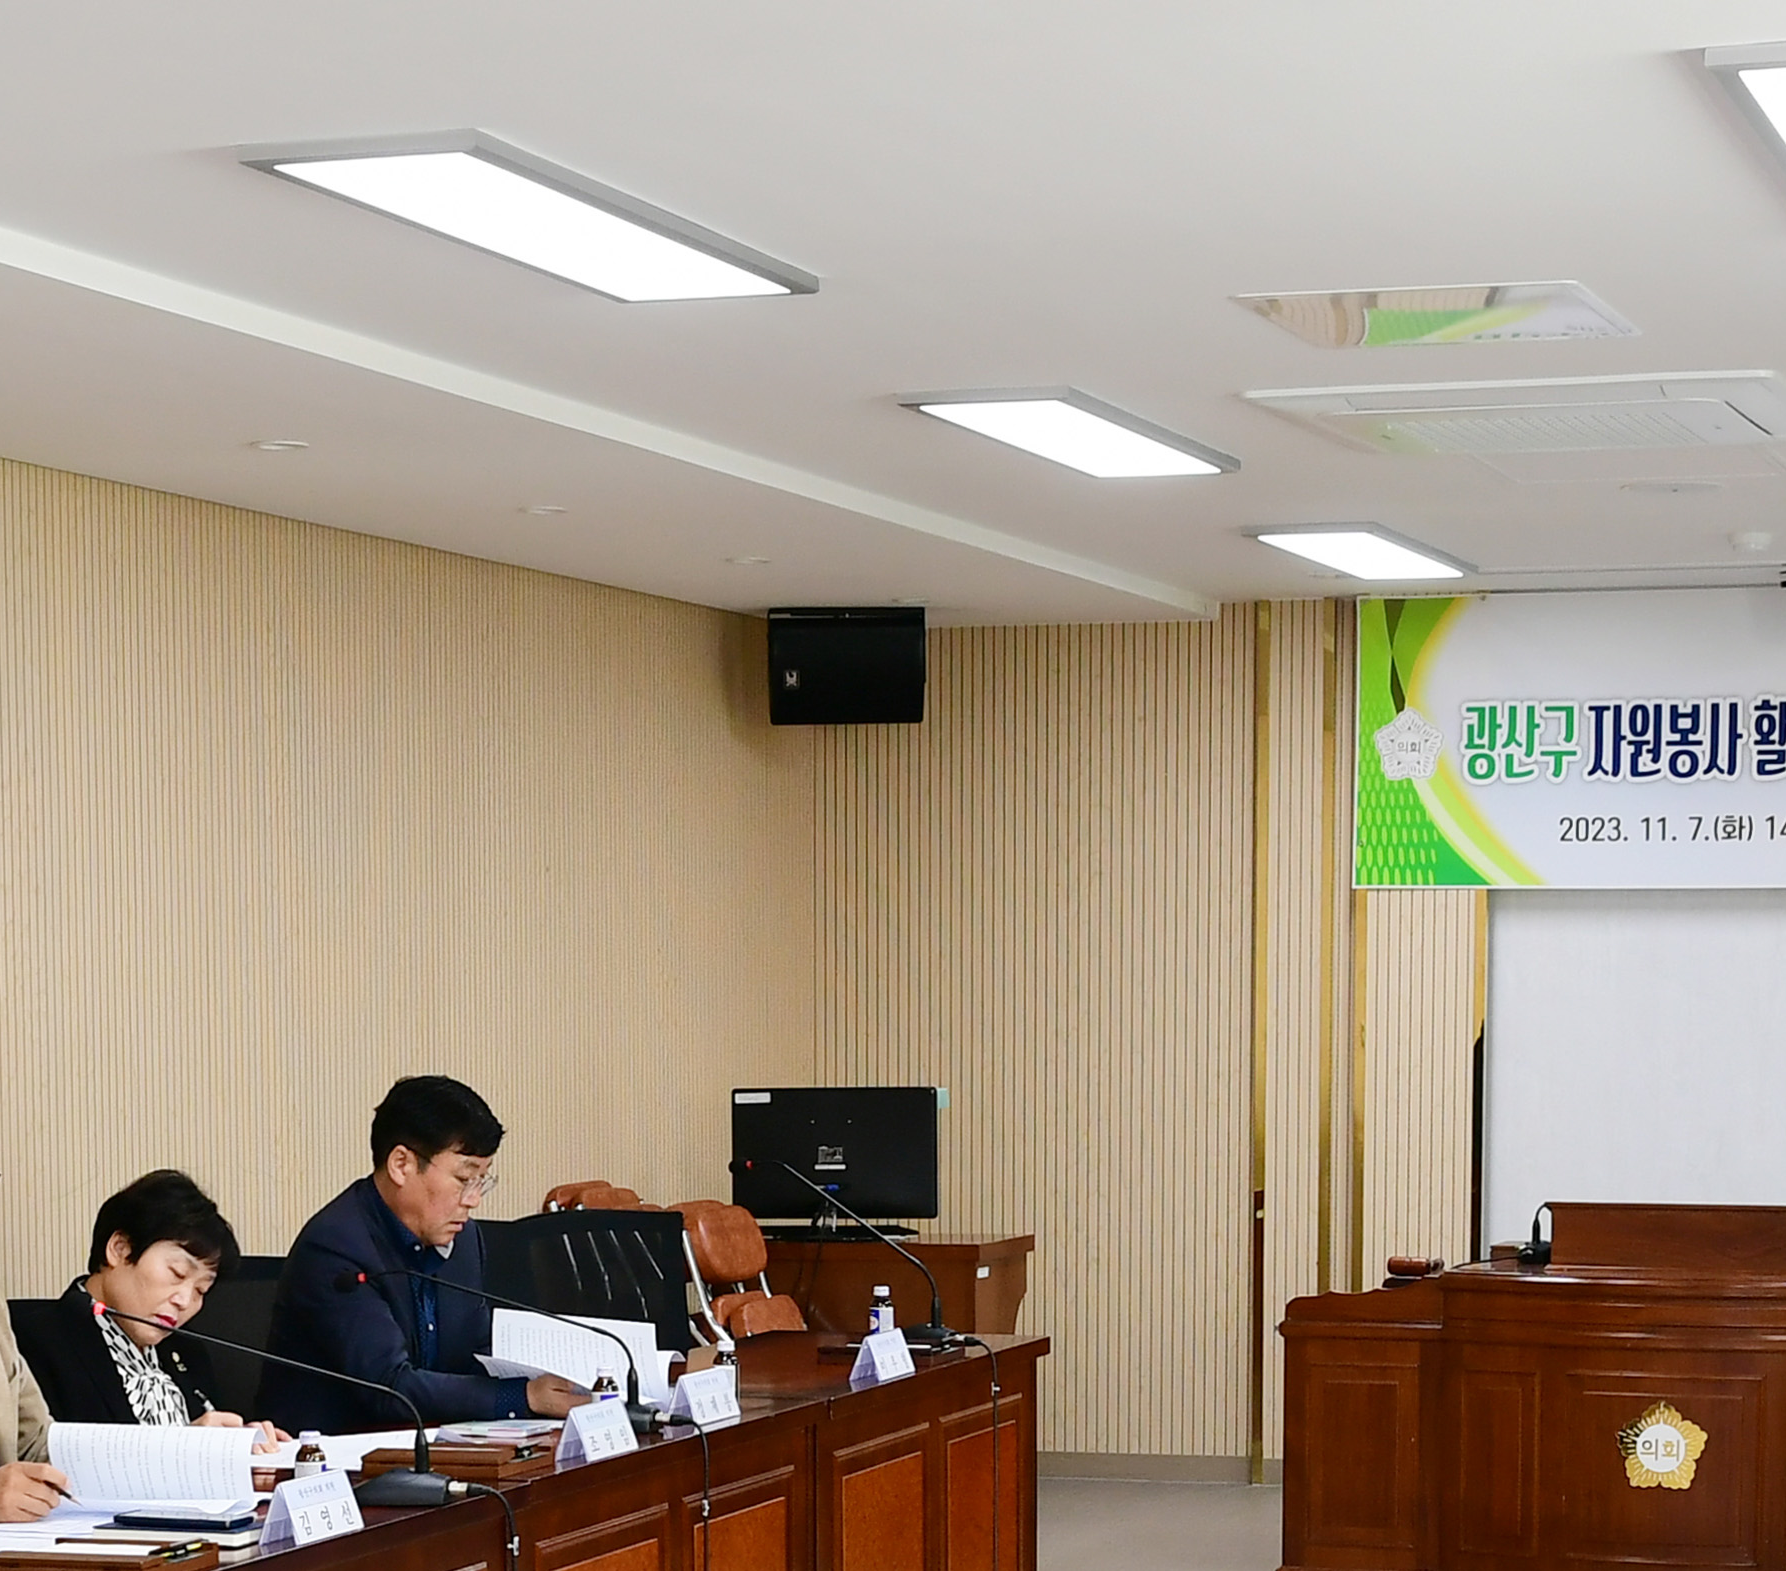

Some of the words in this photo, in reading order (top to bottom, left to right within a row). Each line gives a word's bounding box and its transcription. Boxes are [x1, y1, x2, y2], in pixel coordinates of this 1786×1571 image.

[1397, 741, 1421, 754] 의회
[1463, 704, 1579, 780] 광산구
[1586, 701, 1744, 778] 자원봉사
[1558, 815, 1629, 842] 2023.
[1640, 815, 1678, 842] 11.
[1688, 815, 1754, 843] 7.(화)
[1639, 1438, 1681, 1462] 의회
